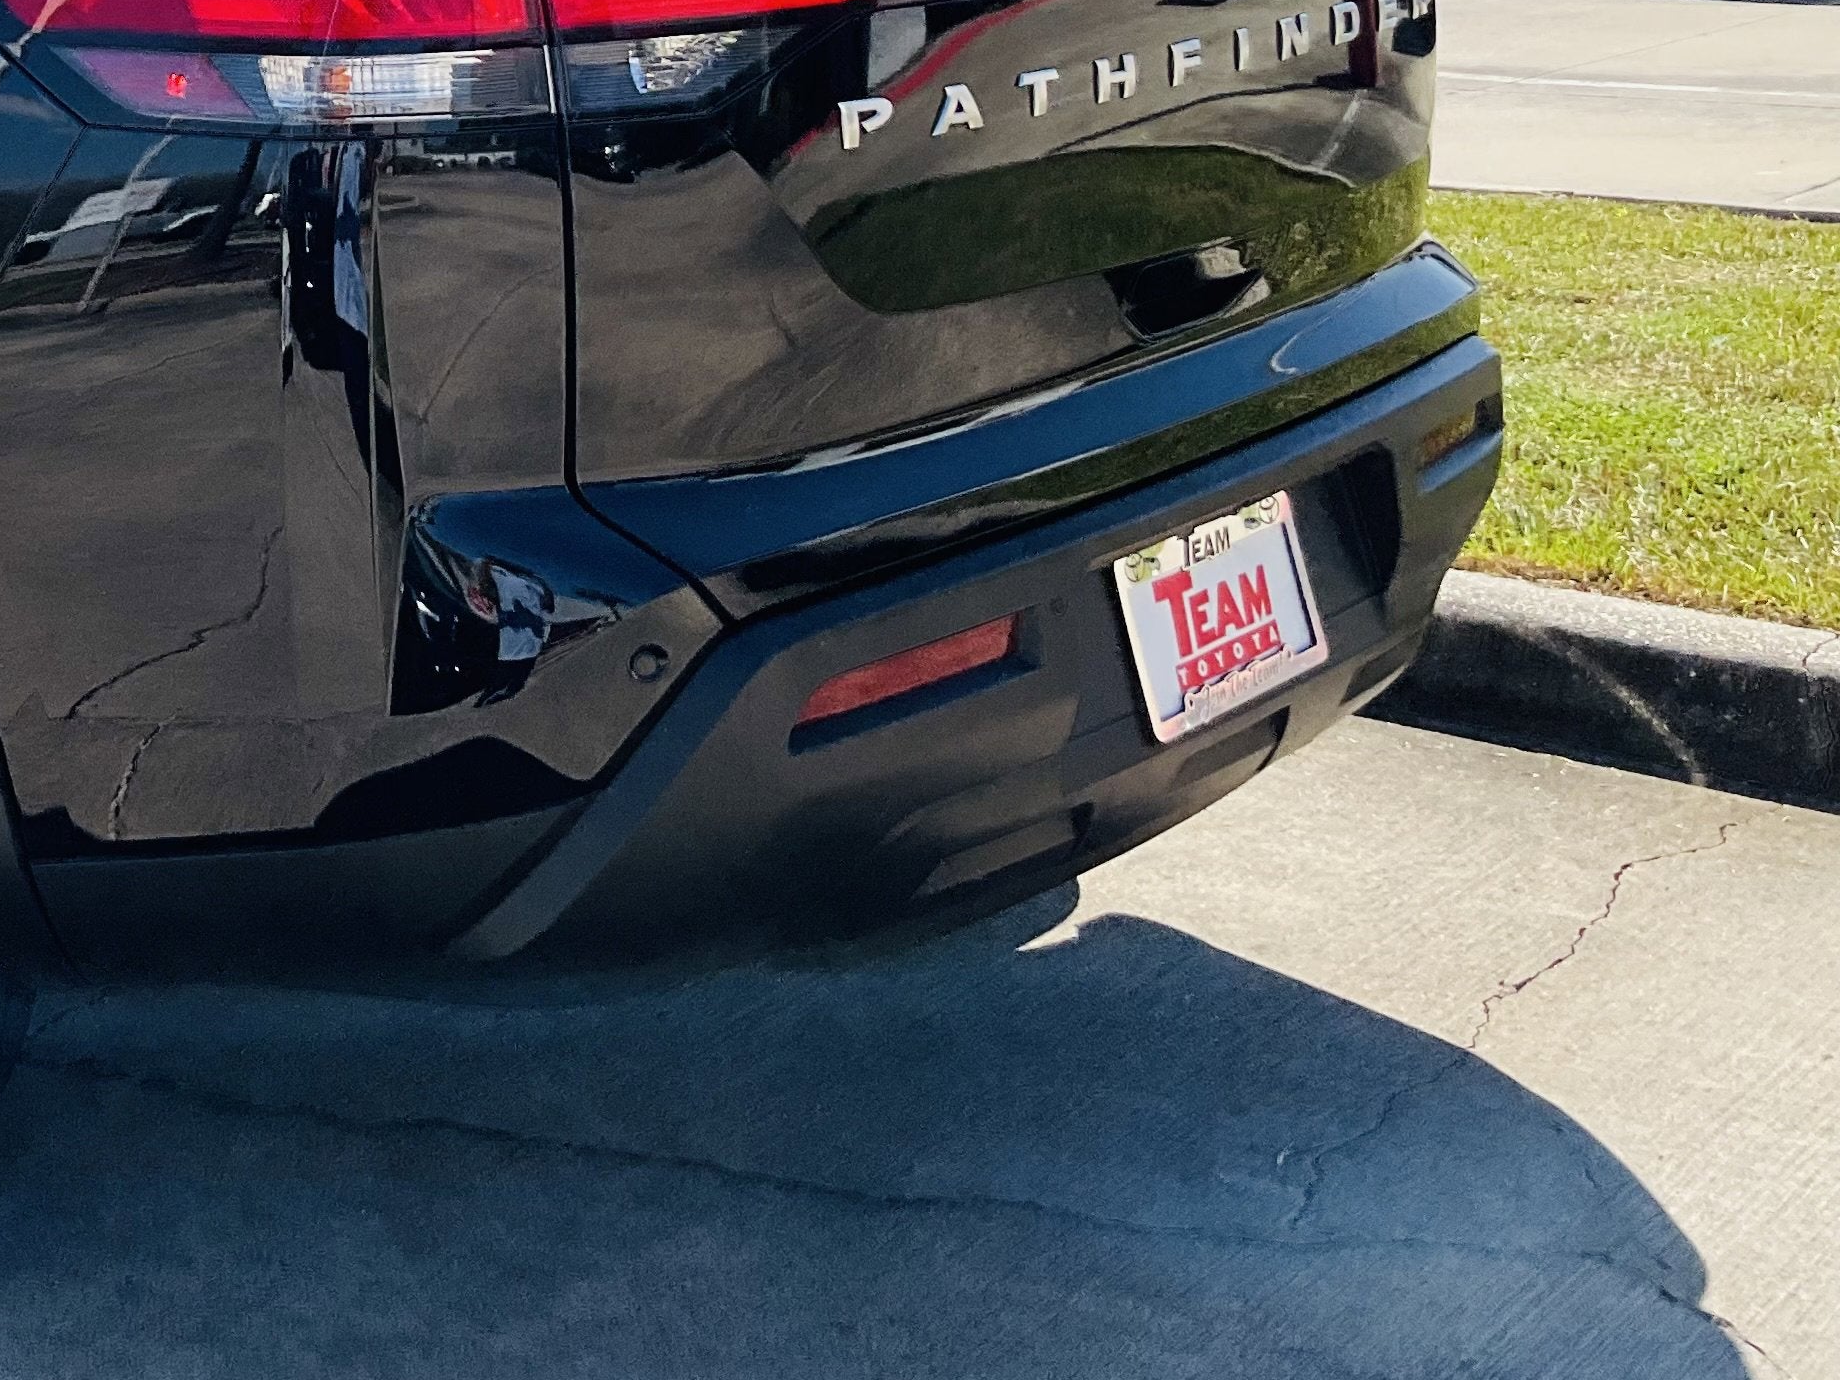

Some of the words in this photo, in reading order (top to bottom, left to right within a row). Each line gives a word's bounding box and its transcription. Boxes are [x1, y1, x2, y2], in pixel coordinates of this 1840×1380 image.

[1178, 524, 1231, 566] TEAM
[1152, 564, 1272, 658] TEAM
[1177, 626, 1279, 686] TOYOTA
